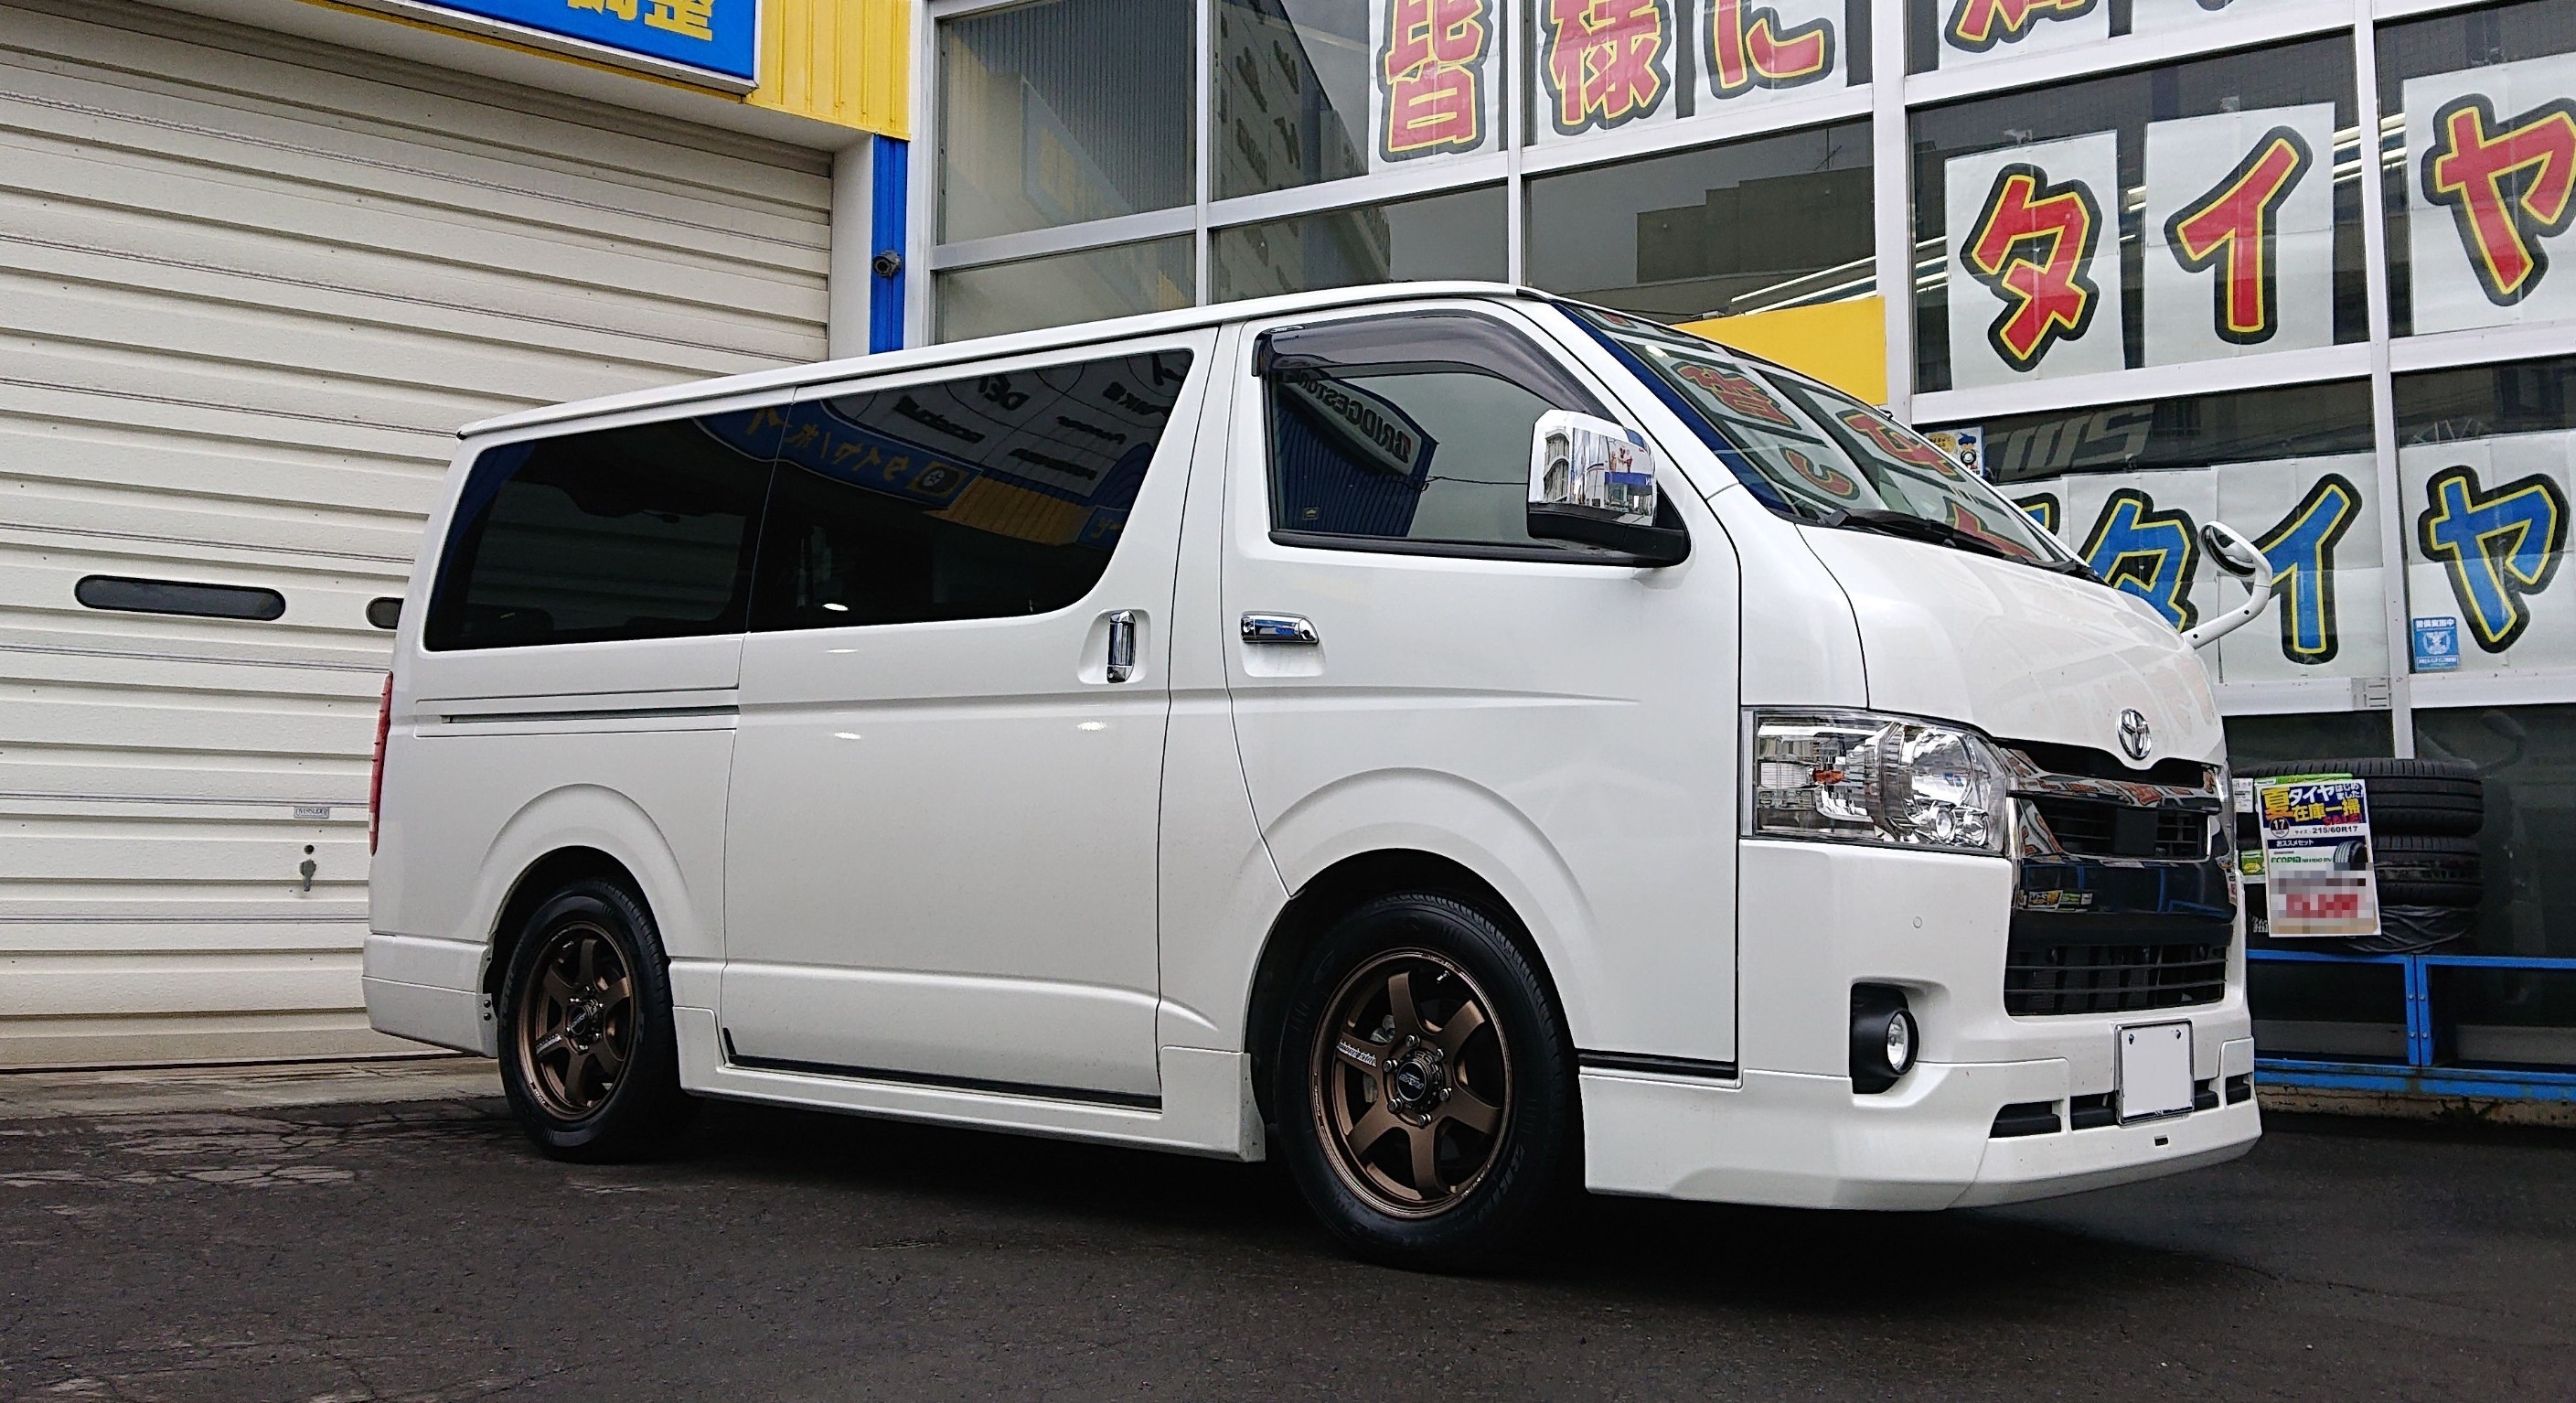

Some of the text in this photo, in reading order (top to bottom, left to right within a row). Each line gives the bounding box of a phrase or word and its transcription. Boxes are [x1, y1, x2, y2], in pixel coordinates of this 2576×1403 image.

[1960, 93, 2576, 372] タイヤ
[2015, 466, 2570, 665] タイヤ
[2292, 798, 2361, 822] 在庫一掃
[2273, 819, 2286, 830] 17
[2312, 825, 2358, 834] 215/60R17
